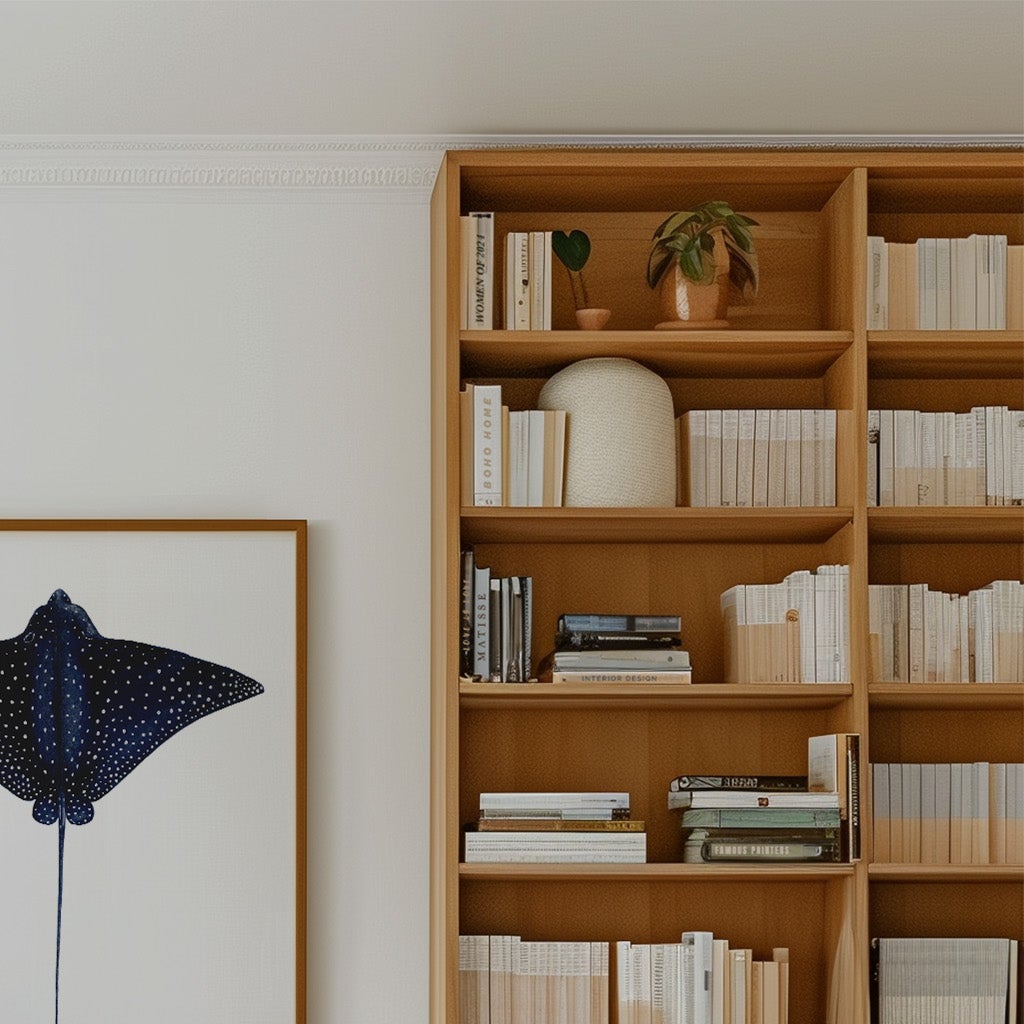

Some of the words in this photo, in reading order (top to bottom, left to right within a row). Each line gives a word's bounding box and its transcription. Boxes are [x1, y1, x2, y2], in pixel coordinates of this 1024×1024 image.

[475, 260, 486, 276] OF
[474, 278, 486, 324] WOMEN
[483, 396, 492, 440] HOME
[483, 446, 492, 490] BOHO
[477, 592, 487, 662] MATISSE
[581, 675, 623, 683] INTERIOR
[626, 675, 658, 683] DESIGN
[714, 845, 748, 856] FAMOUS
[751, 845, 790, 856] PAINTERS
